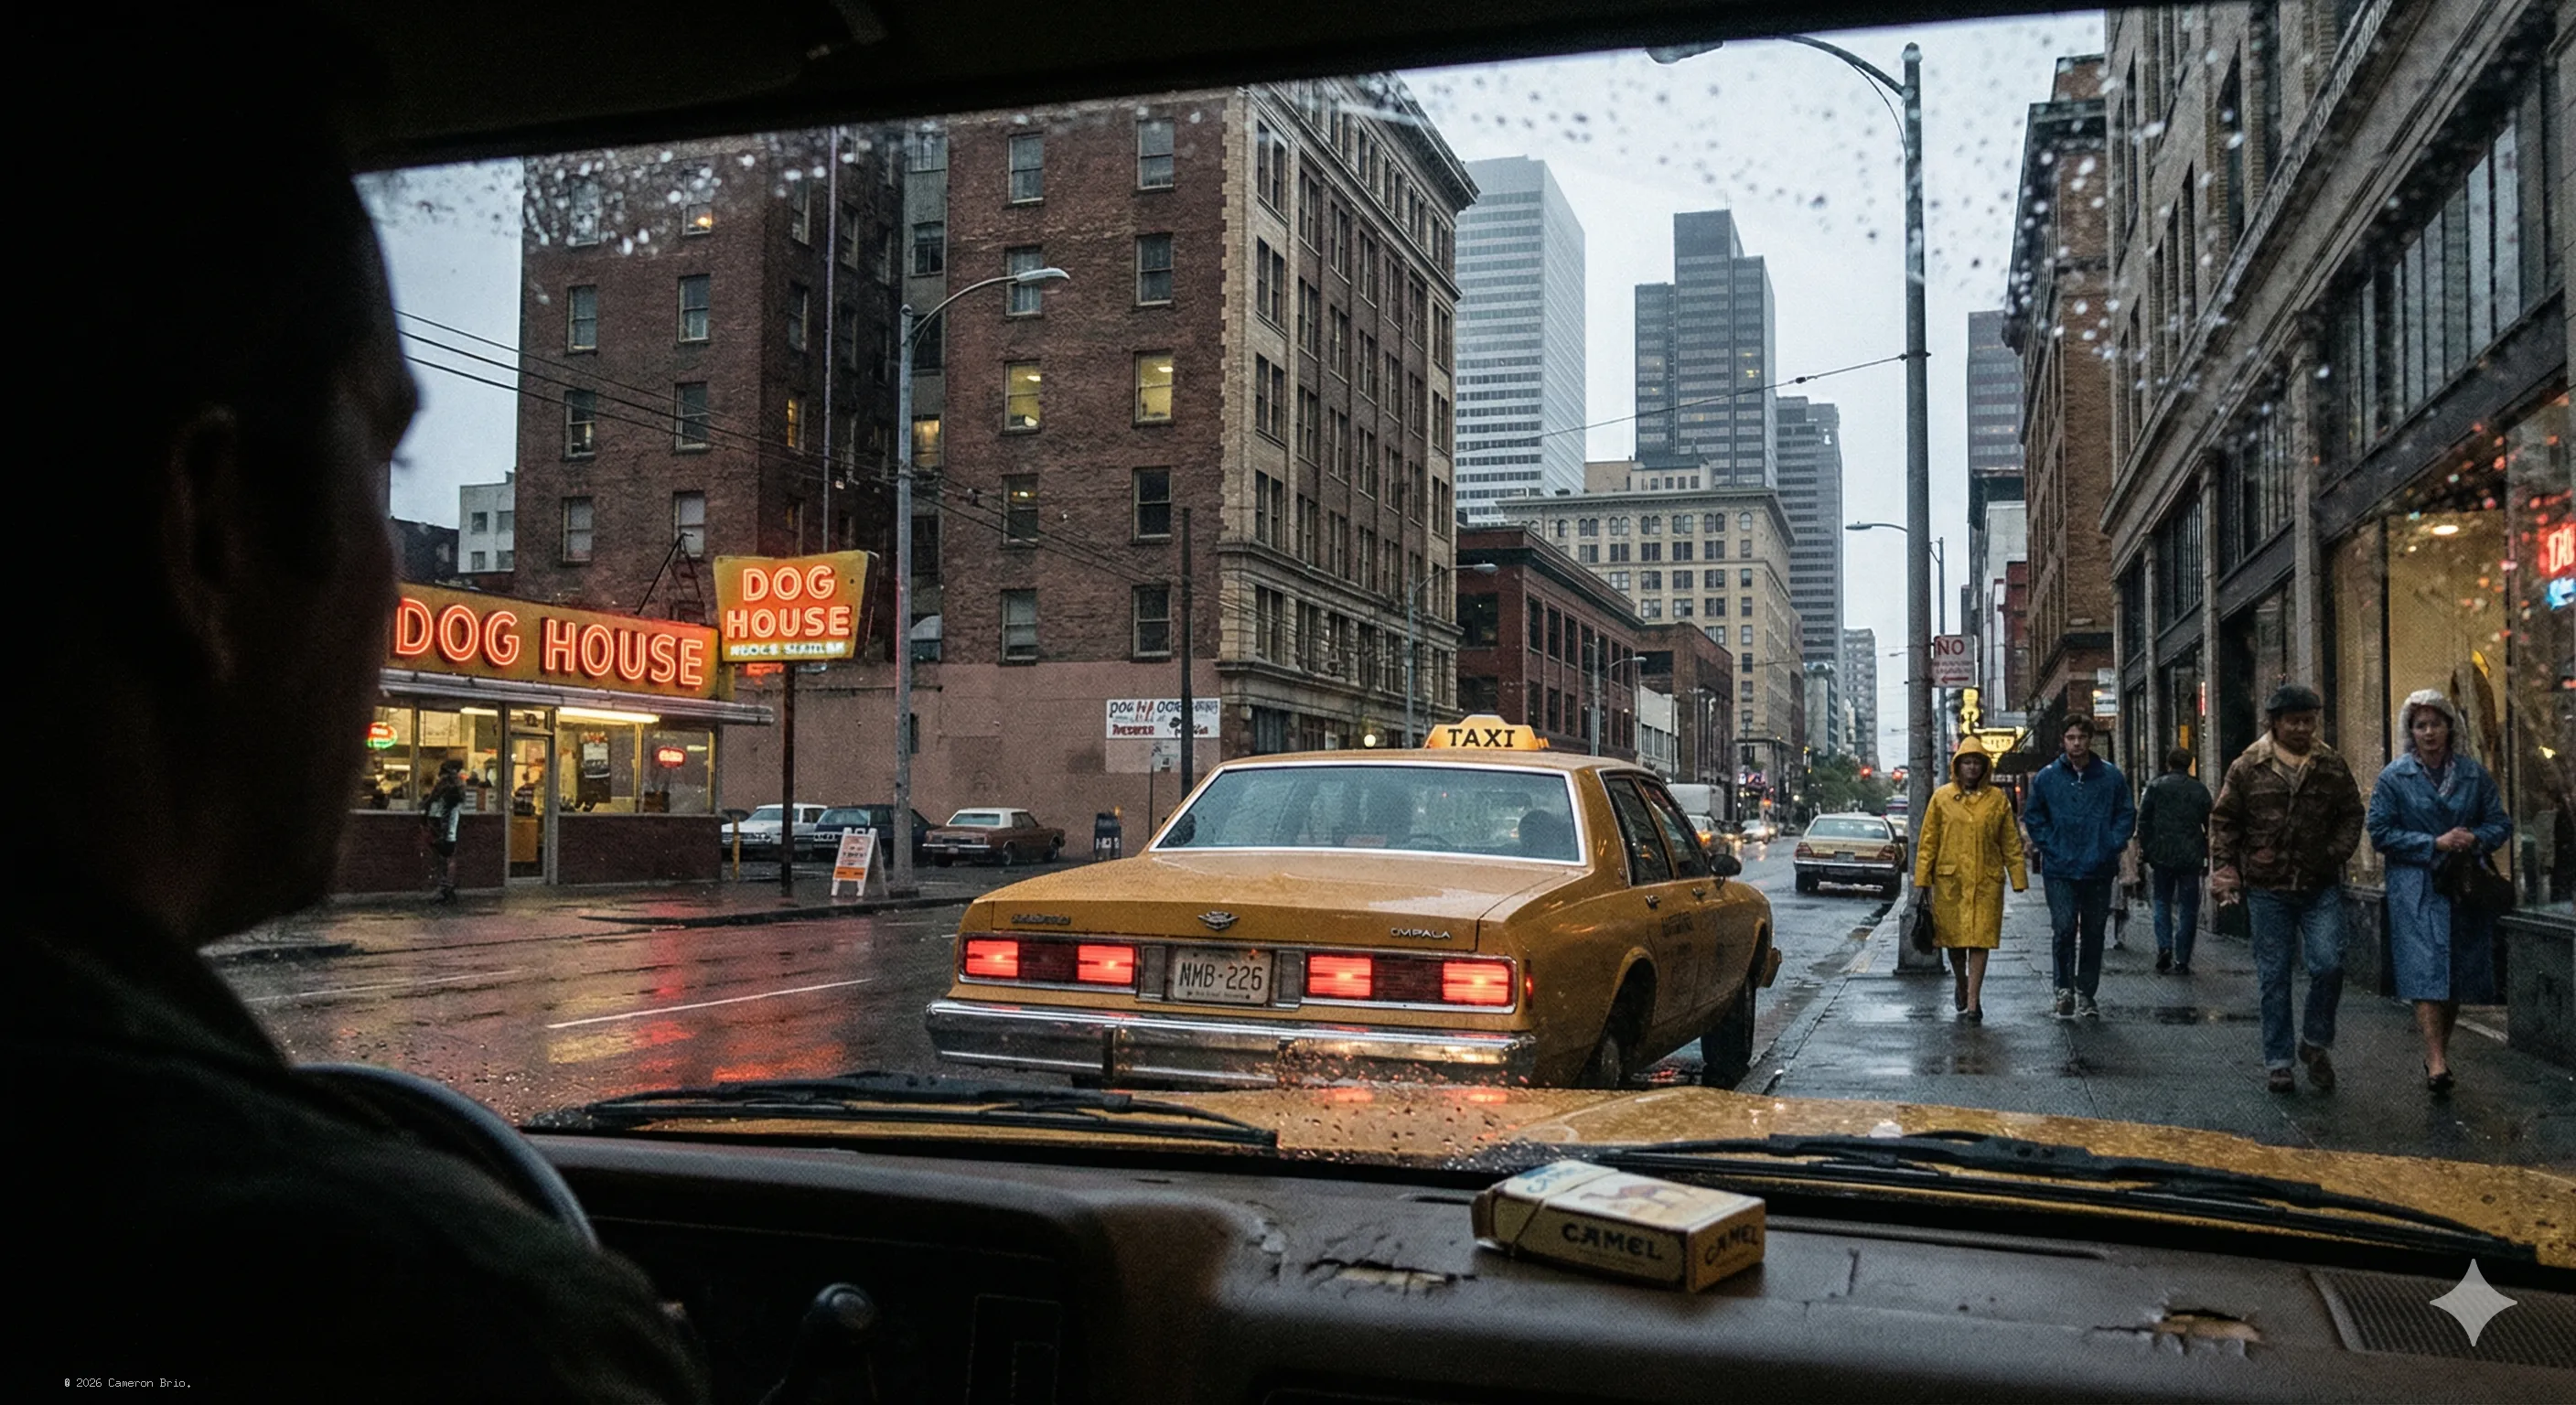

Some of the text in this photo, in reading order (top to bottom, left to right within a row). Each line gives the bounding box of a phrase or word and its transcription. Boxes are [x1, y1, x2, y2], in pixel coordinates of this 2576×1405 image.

[743, 565, 835, 601] DOG
[726, 606, 850, 639] HOUSE
[395, 598, 703, 686] DOG HOUSE
[1937, 639, 1965, 655] NO
[1447, 728, 1516, 747] TAXI
[1562, 1222, 1663, 1260] CAMEL
[1705, 1225, 1757, 1266] CAMEL
